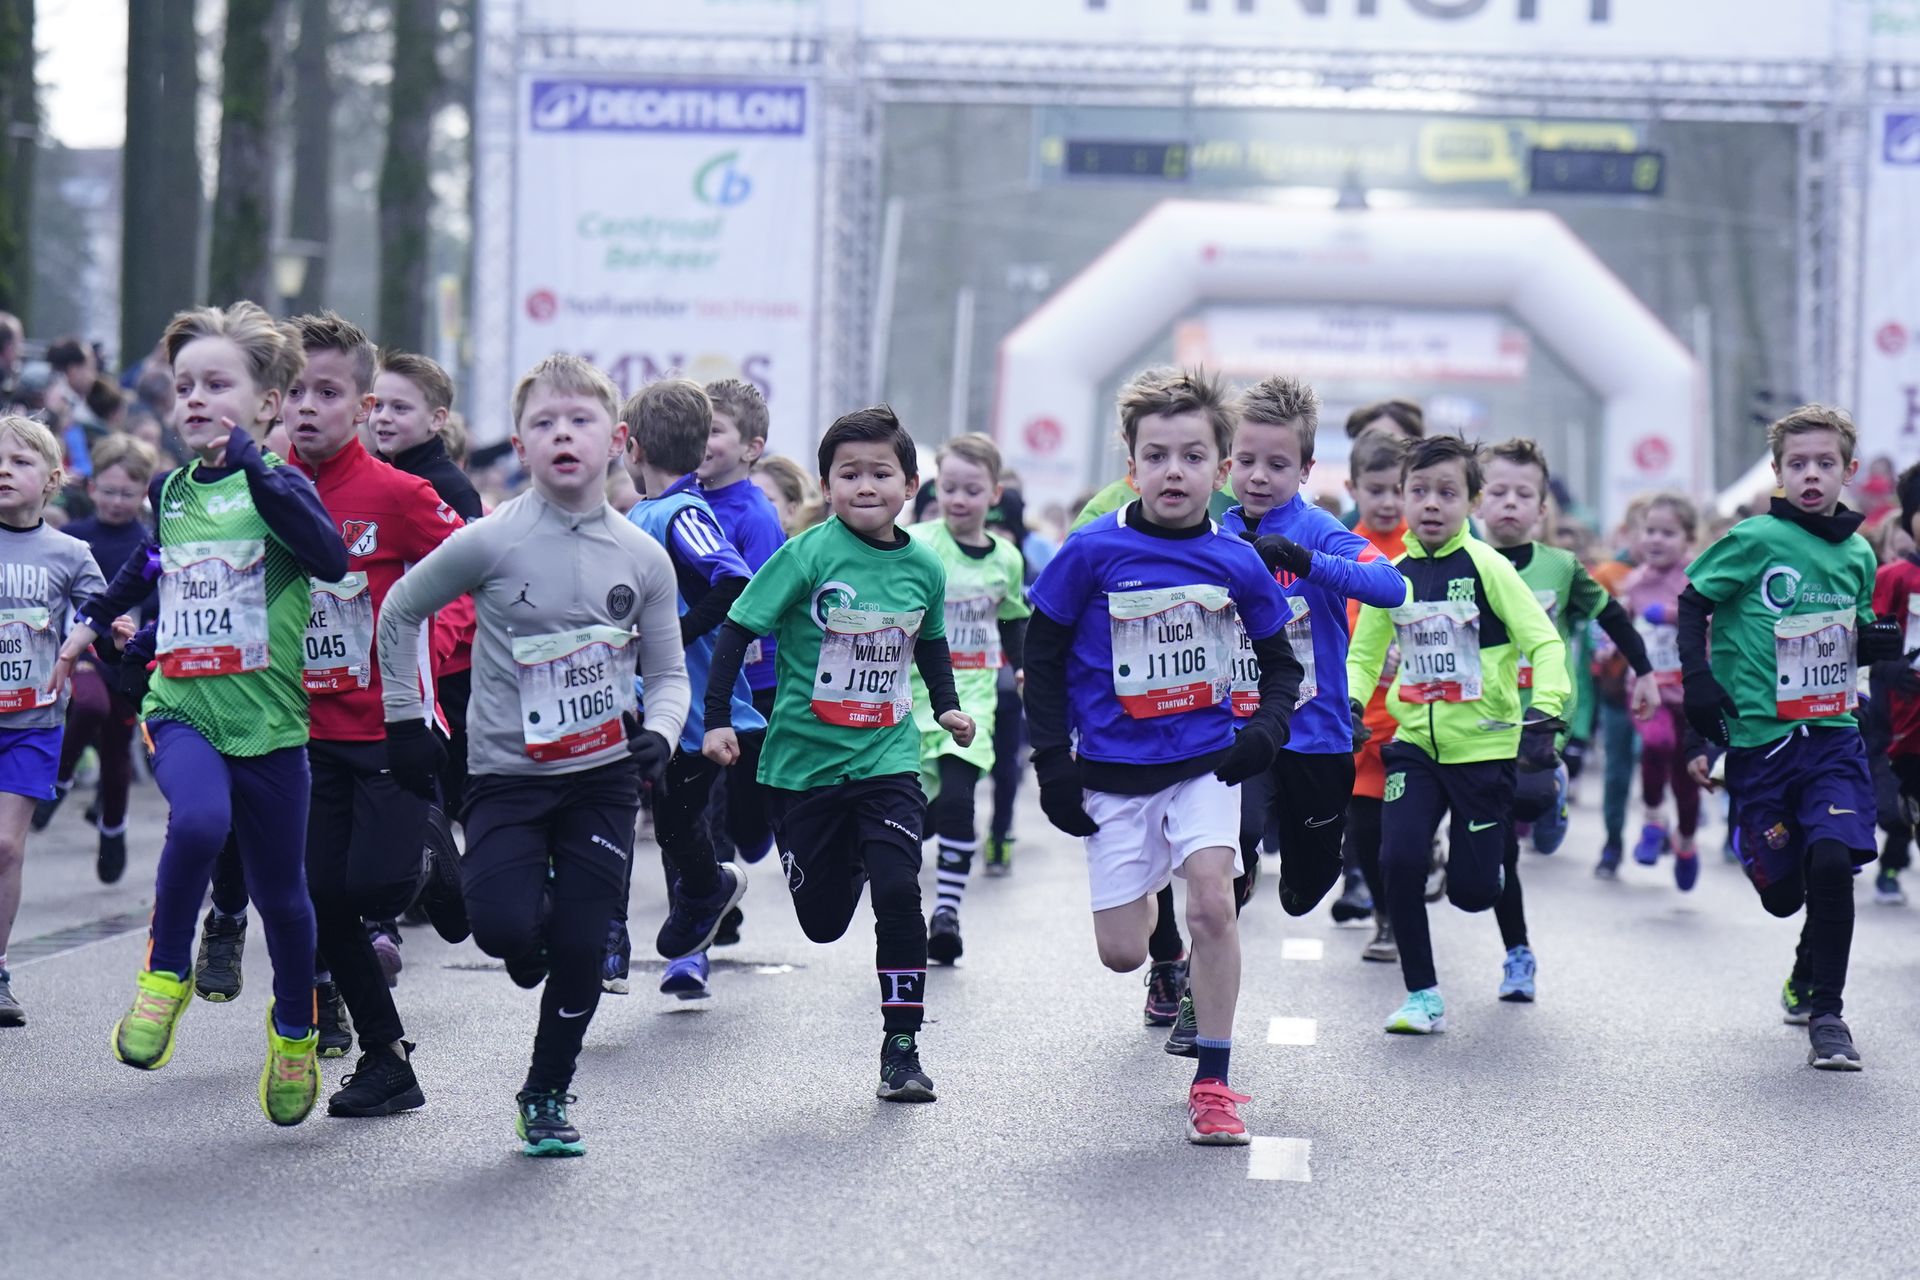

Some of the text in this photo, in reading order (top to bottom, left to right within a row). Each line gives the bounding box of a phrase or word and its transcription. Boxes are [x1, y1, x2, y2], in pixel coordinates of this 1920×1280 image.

[589, 87, 801, 129] DECATHLON
[6, 562, 49, 601] NBA
[182, 580, 218, 600] ZACH
[1801, 592, 1815, 604] DE
[173, 607, 233, 637] J1124
[1158, 622, 1194, 644] LUCA
[305, 634, 347, 661] 045
[1239, 633, 1252, 650] JE
[1415, 631, 1448, 646] MAIRO
[1817, 641, 1836, 659] JOP
[855, 644, 902, 663] WILLEM
[1146, 646, 1206, 680] J1106
[0, 659, 33, 682] 057
[564, 662, 605, 689] JESSE
[1231, 658, 1260, 682] J10
[1802, 661, 1848, 688] J1025
[557, 684, 614, 726] J1066
[1156, 694, 1195, 711] STARTVAK 2
[1239, 702, 1260, 711] STARTV
[886, 973, 918, 1001] F
